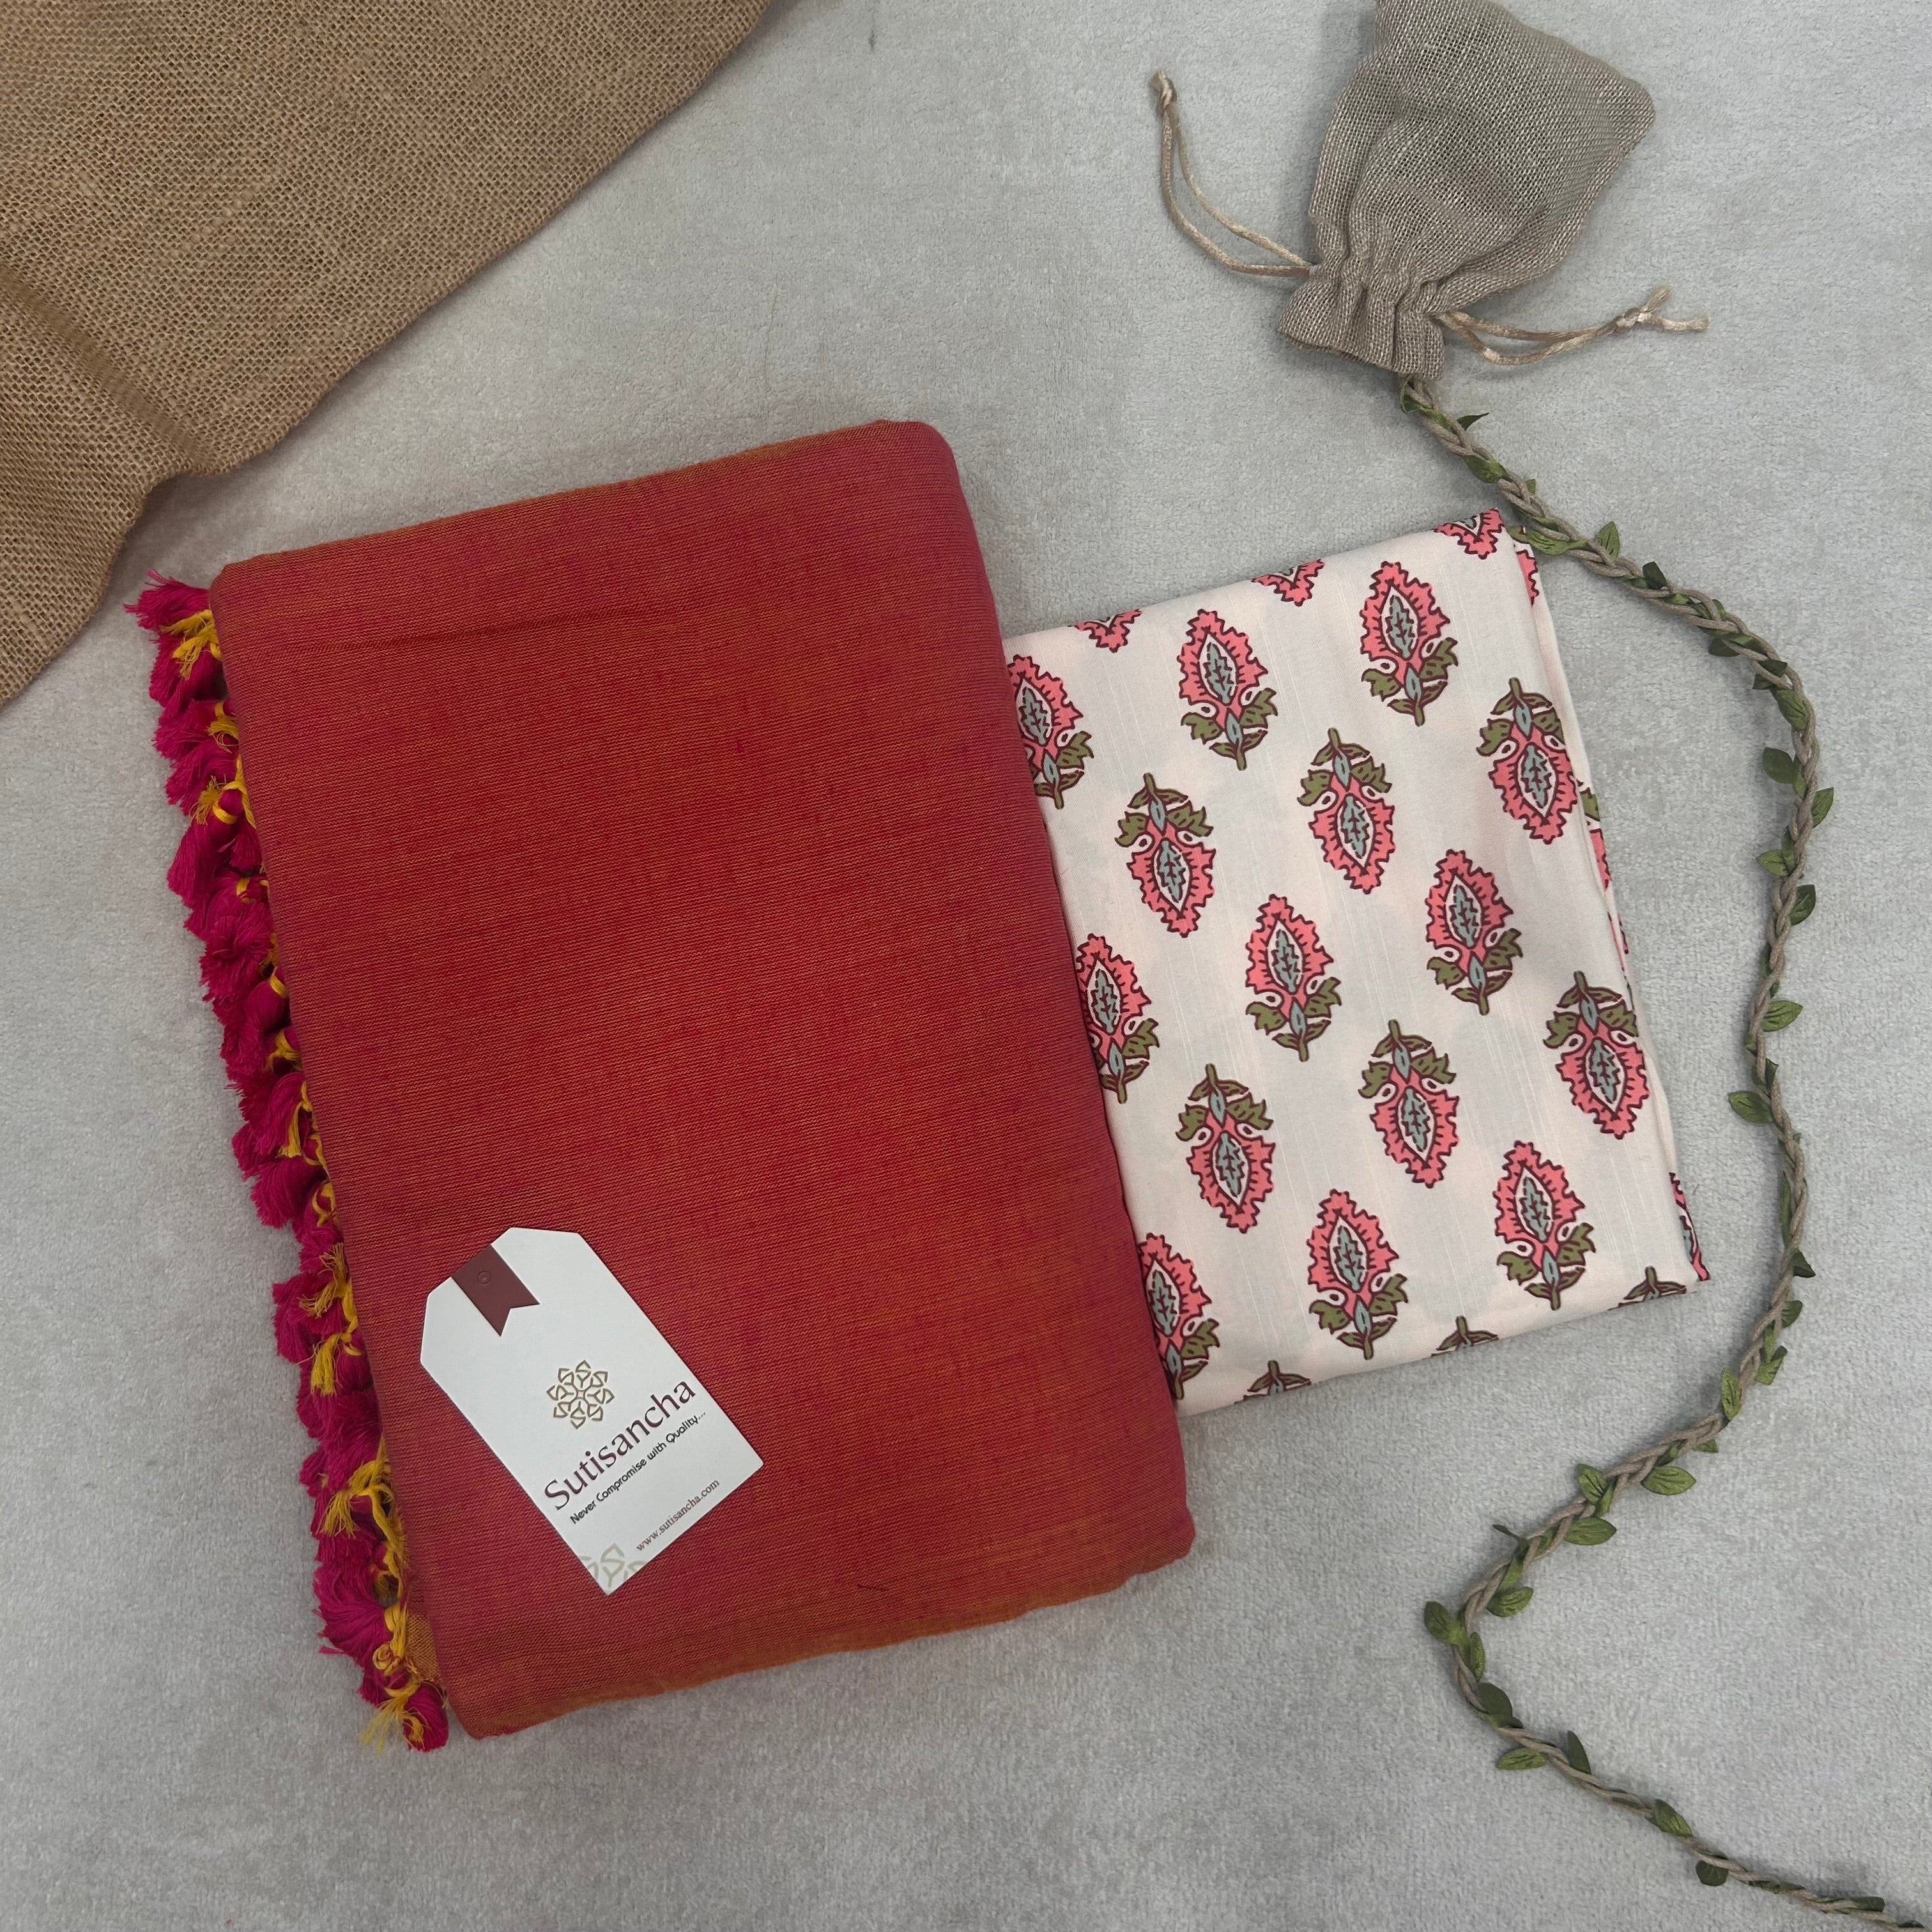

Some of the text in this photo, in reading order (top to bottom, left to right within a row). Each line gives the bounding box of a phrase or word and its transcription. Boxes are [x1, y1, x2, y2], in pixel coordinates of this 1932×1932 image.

[544, 1381, 696, 1510] Sutisancha
[570, 1501, 597, 1524] Never
[596, 1458, 647, 1503] Compromise
[647, 1442, 667, 1460] with
[636, 1478, 720, 1552] www.sutisancha.com
